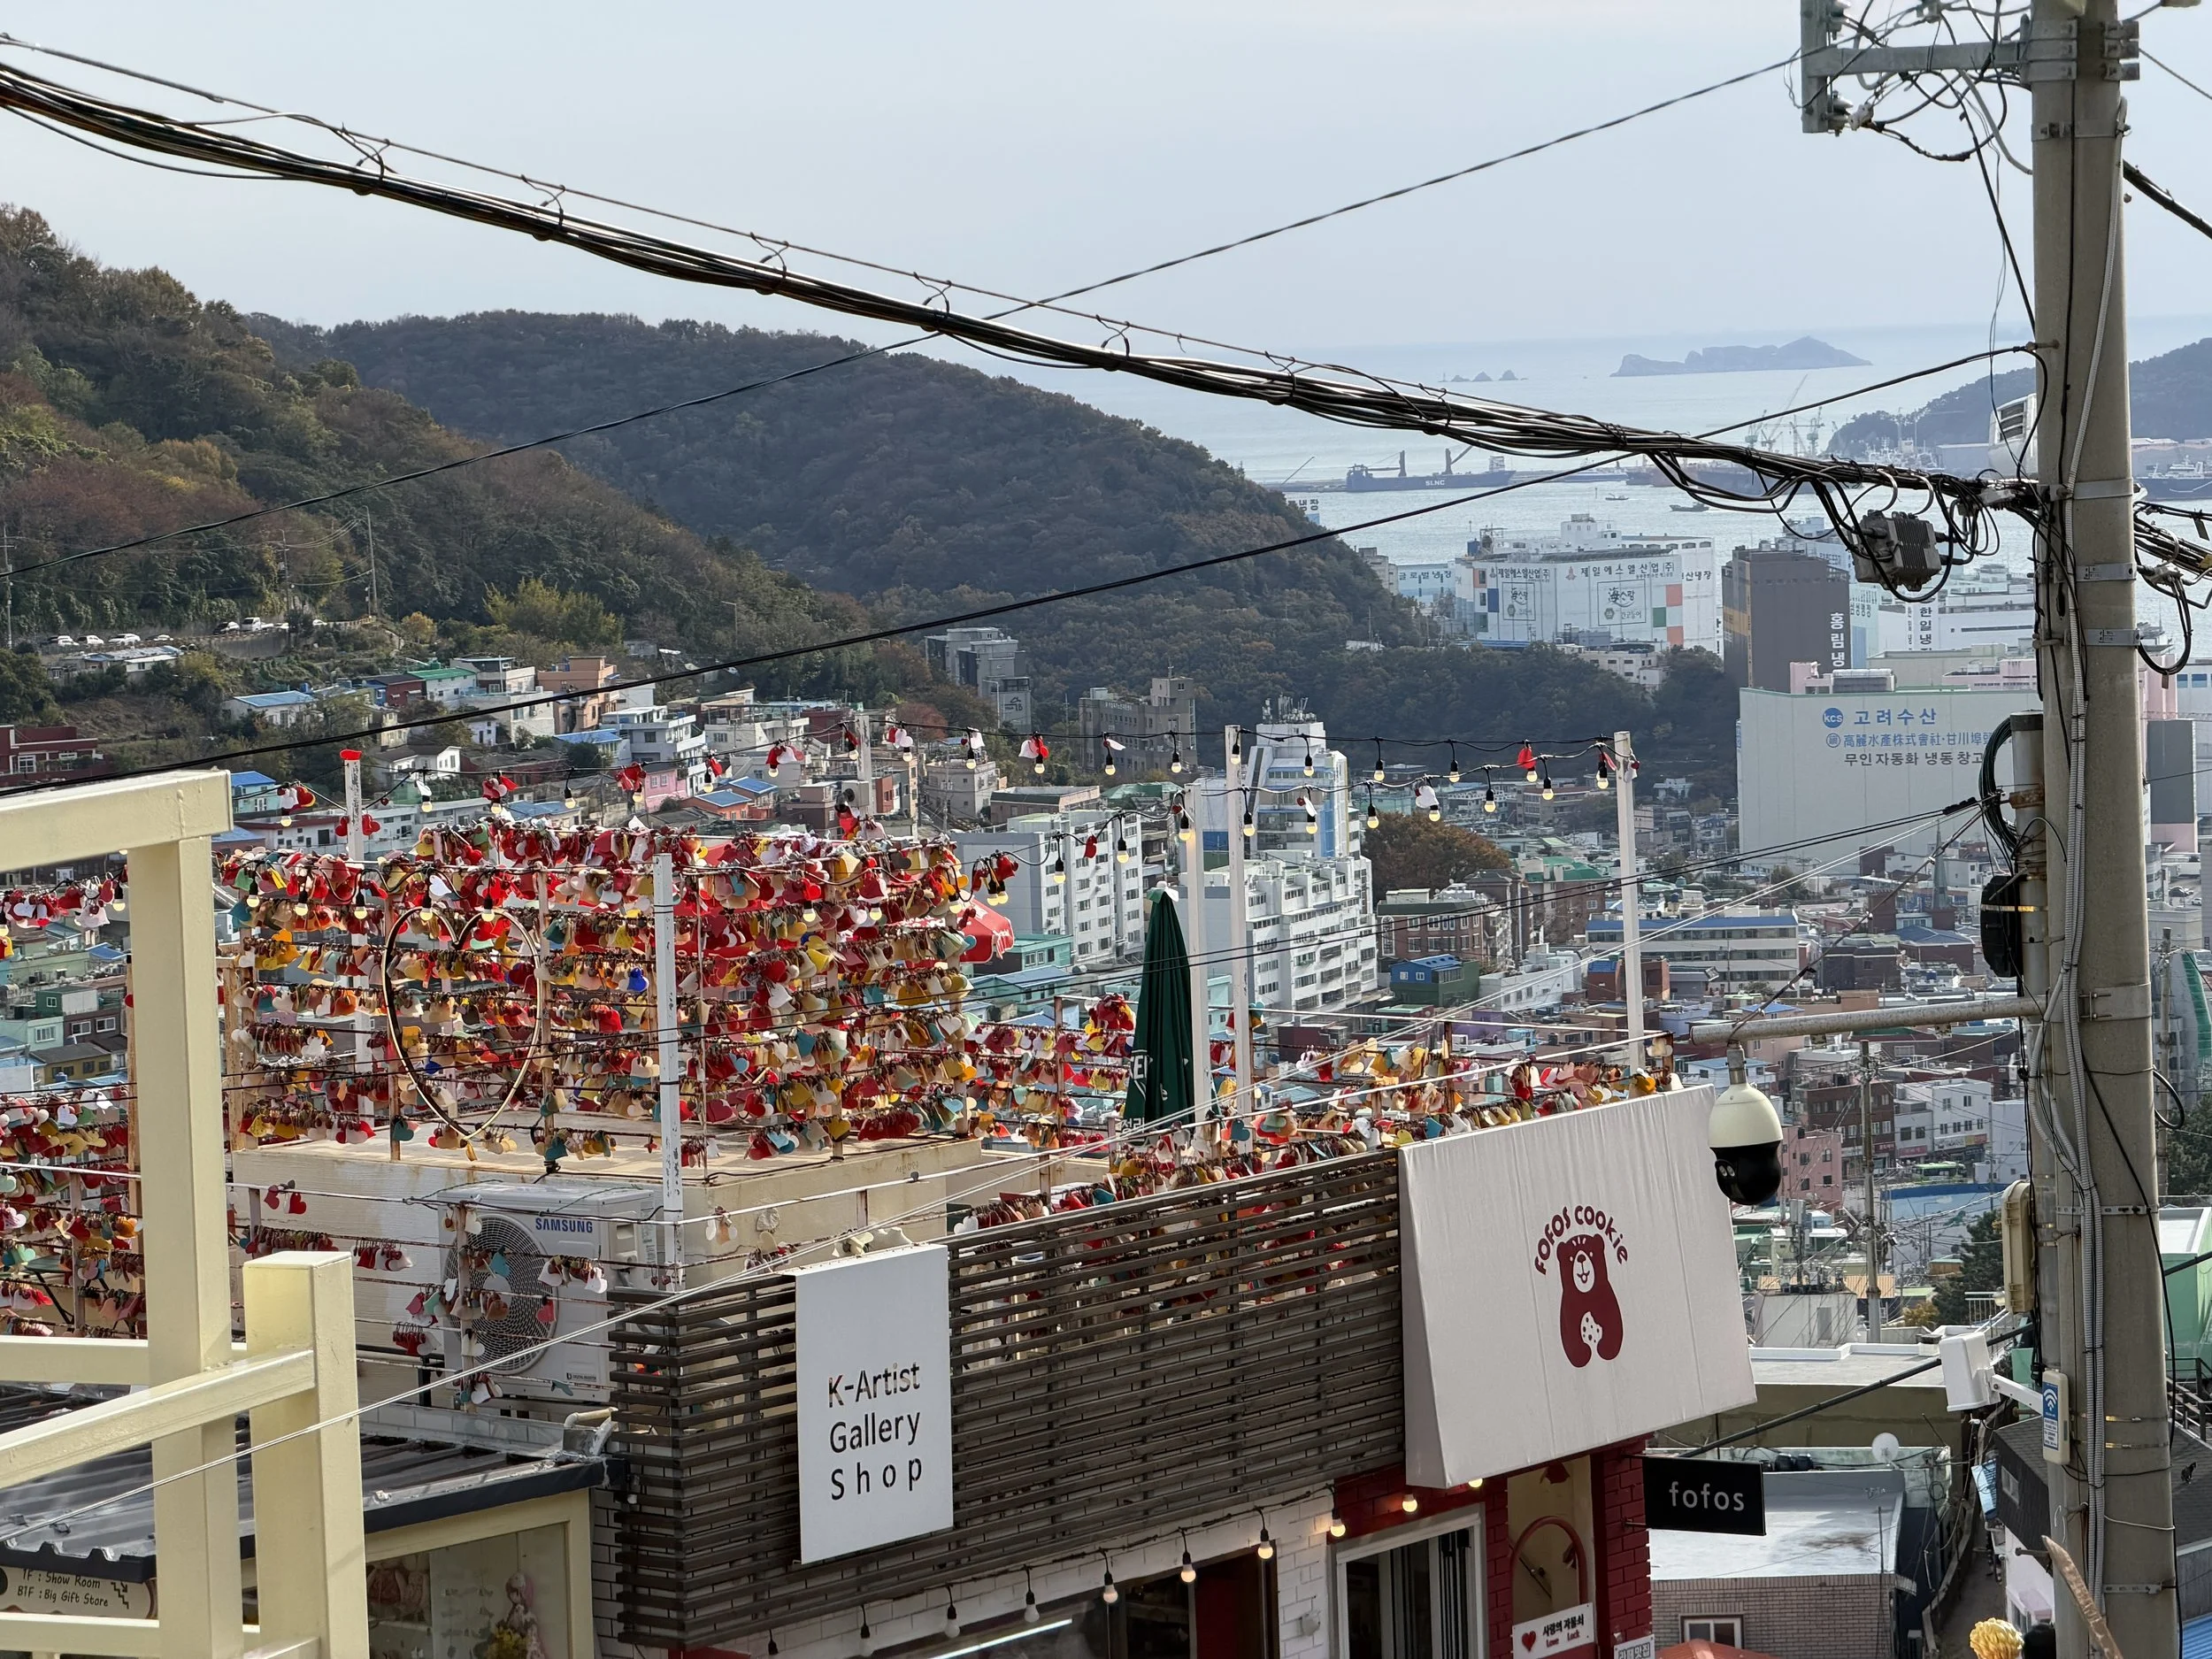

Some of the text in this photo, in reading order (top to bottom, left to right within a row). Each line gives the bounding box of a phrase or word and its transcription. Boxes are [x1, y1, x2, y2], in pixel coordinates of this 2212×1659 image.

[1918, 606, 1933, 650] 한일냉
[1854, 708, 1937, 726] 고려수산
[535, 1217, 594, 1233] SAMSUNG
[828, 1362, 921, 1408] K-Artist
[829, 1411, 921, 1455] Gallery
[1669, 1481, 1745, 1511] fofos
[45, 1571, 70, 1586] Show
[75, 1575, 101, 1589] Room
[17, 1585, 35, 1597] B1F
[61, 1590, 81, 1603] Gift
[83, 1591, 109, 1608] Store
[1542, 1614, 1585, 1637] 사랑의 자물쇠
[1546, 1630, 1580, 1647] Love Lock
